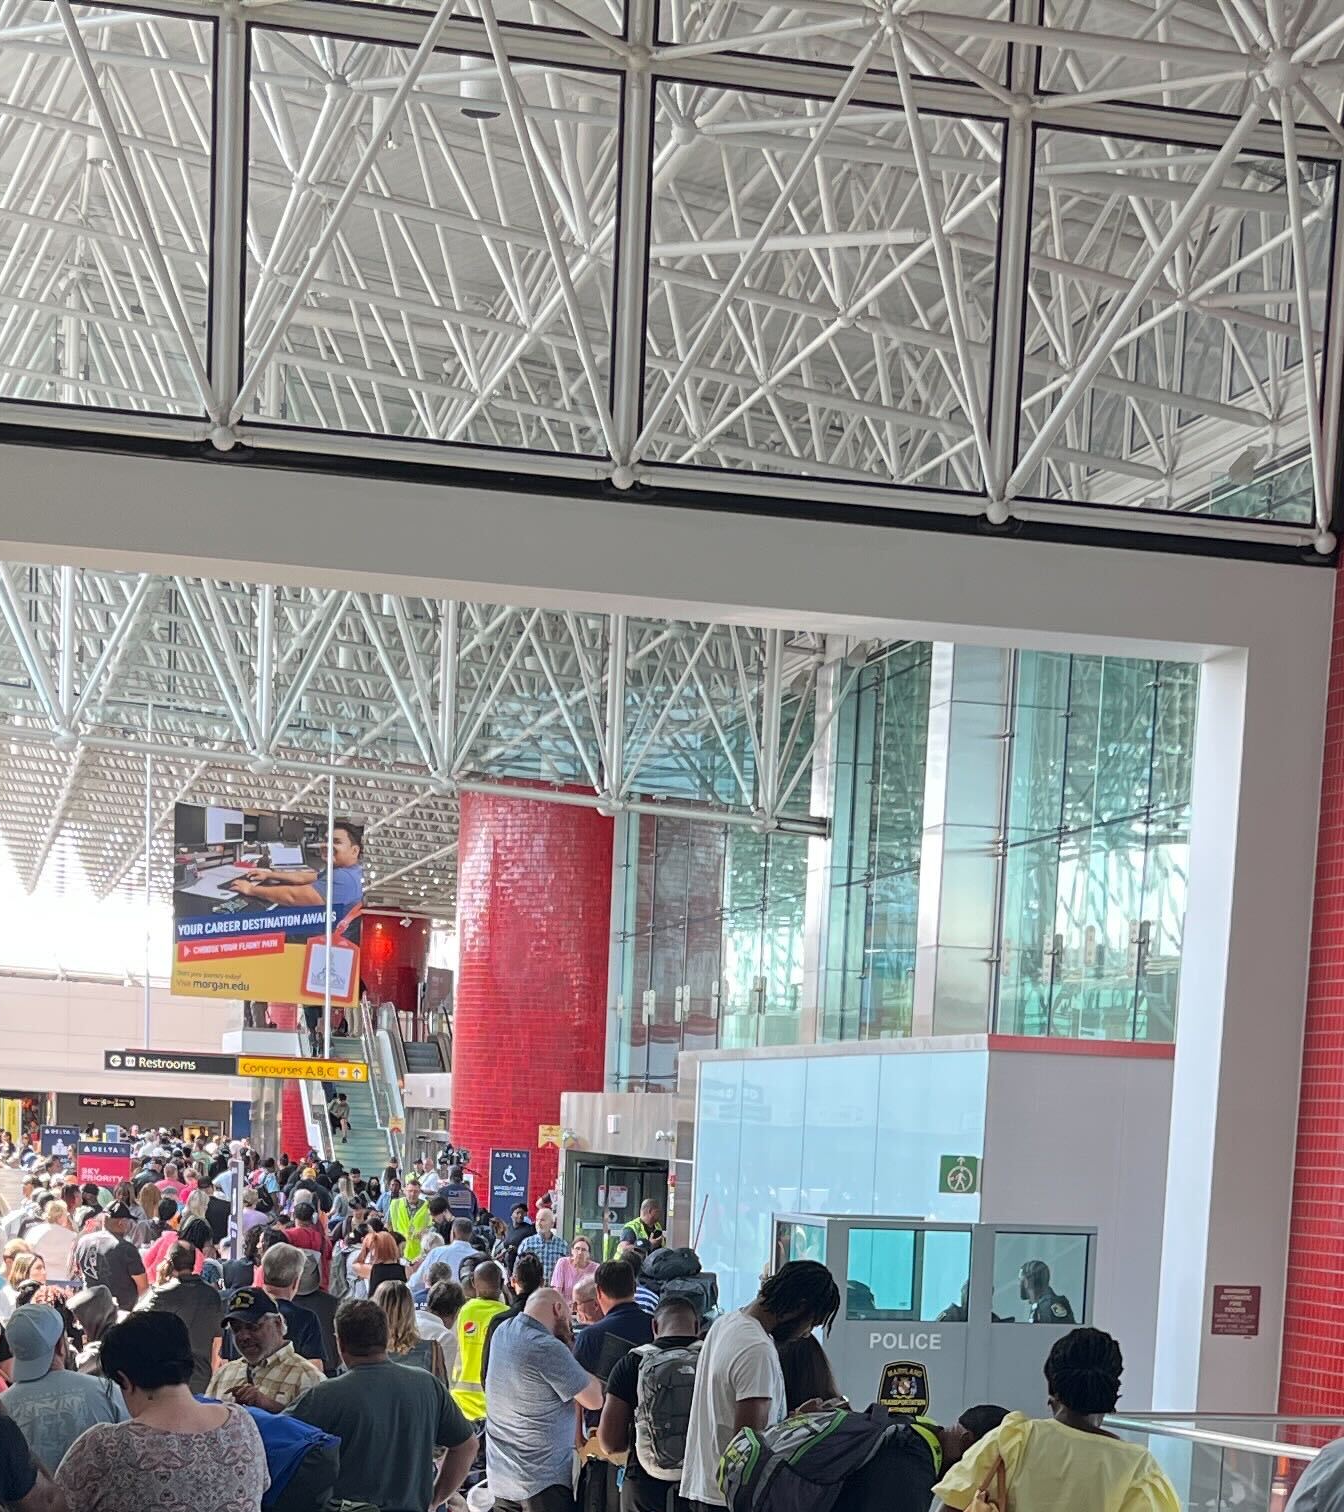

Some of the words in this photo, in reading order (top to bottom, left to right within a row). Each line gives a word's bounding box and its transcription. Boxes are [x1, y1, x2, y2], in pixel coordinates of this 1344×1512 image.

[178, 922, 203, 936] YOUR
[204, 920, 240, 934] CAREER
[242, 914, 300, 931] DESTINATION
[301, 911, 337, 925] AWAIS
[192, 980, 250, 991] morgan.edu
[138, 1057, 196, 1070] Restrooms
[242, 1063, 303, 1076] Concourses
[92, 1146, 119, 1154] DELTA
[81, 1167, 101, 1175] SKY
[80, 1174, 124, 1184] PRIORITY
[869, 1332, 942, 1350] POLICE
